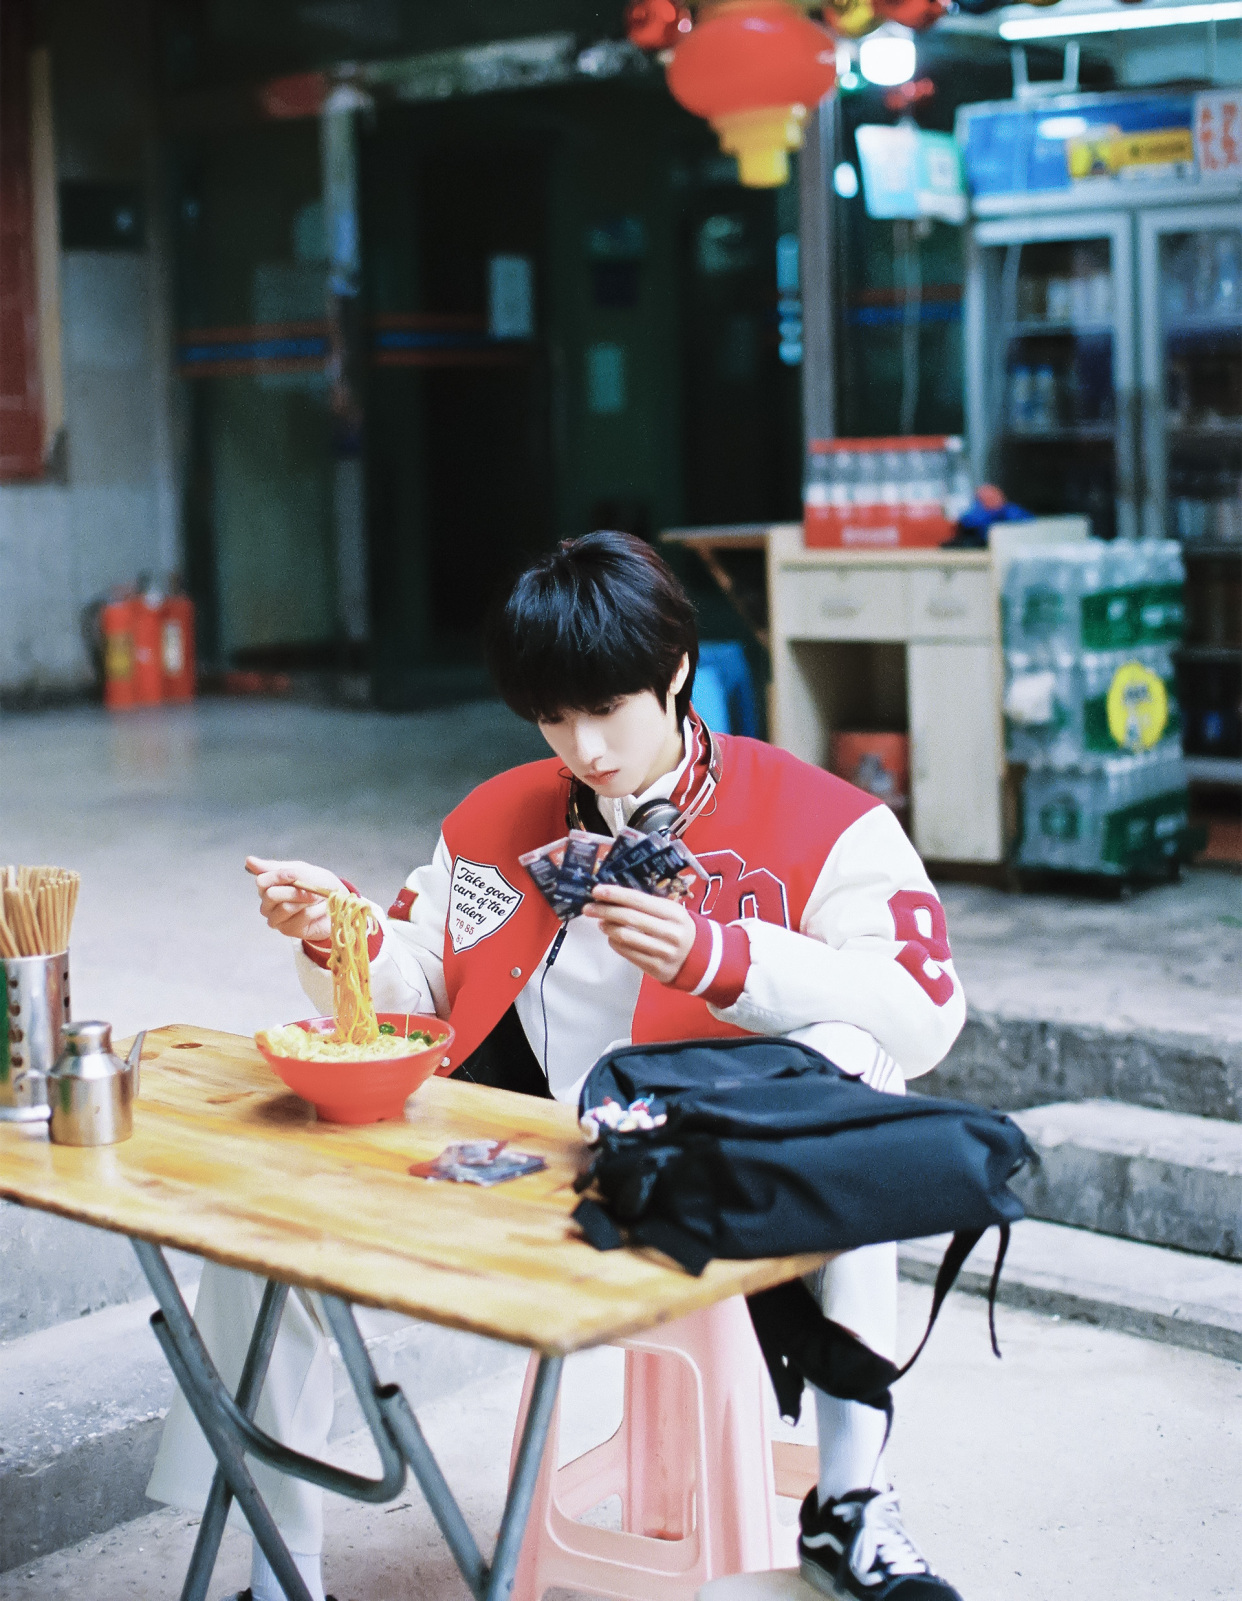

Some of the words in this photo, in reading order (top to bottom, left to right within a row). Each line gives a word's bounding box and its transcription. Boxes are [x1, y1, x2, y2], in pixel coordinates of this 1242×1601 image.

[453, 884, 476, 900] care
[476, 897, 489, 910] of
[487, 899, 506, 917] the
[457, 867, 485, 889] Take
[484, 886, 517, 905] good
[456, 902, 487, 925] eldery
